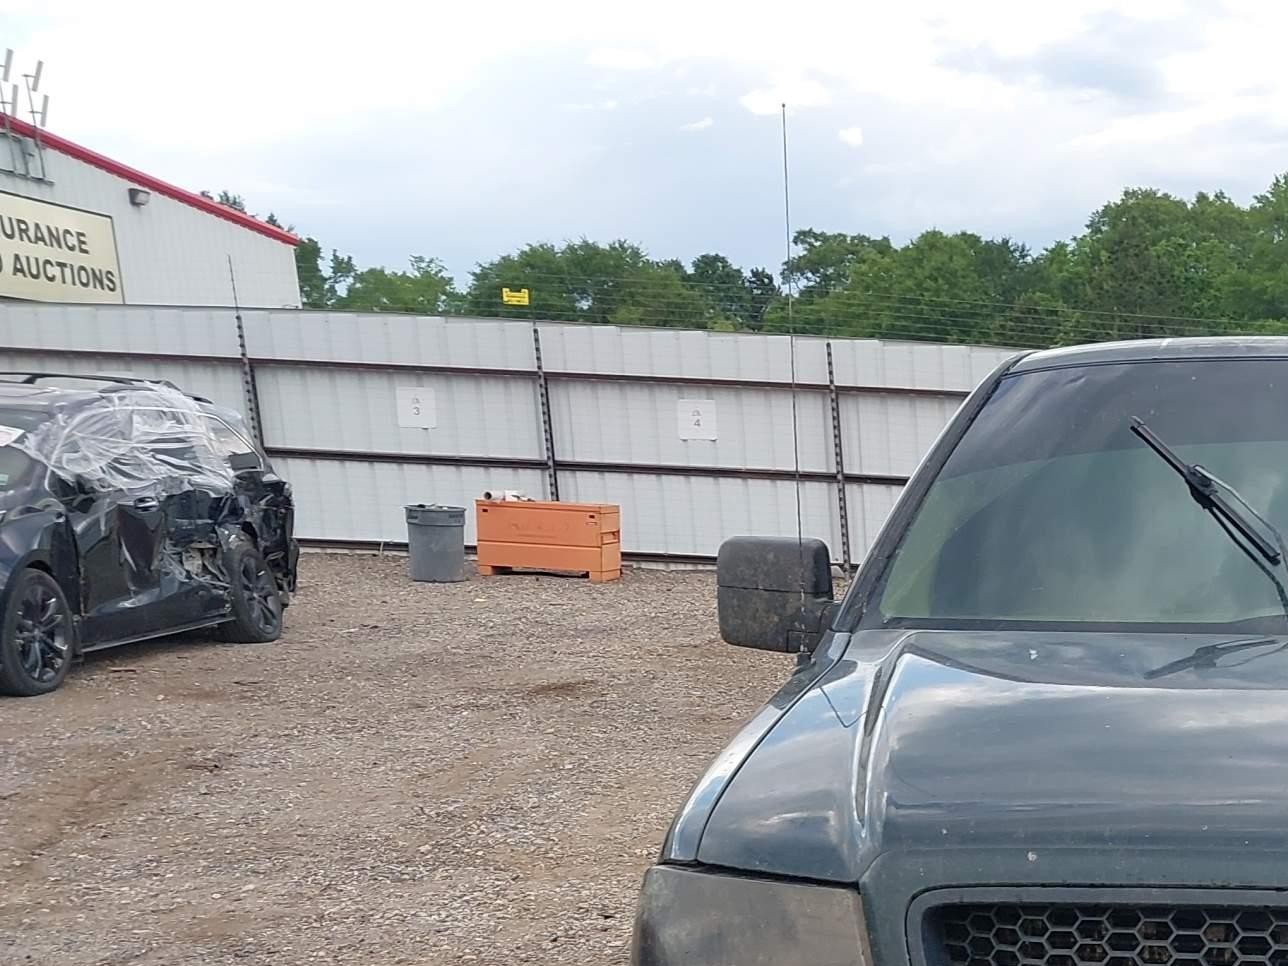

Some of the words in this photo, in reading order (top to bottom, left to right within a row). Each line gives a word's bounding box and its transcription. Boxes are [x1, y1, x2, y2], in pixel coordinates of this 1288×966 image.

[0, 215, 90, 254] URANCE
[12, 253, 117, 292] AUCTIONS
[412, 406, 420, 416] 3
[693, 418, 701, 428] 4
